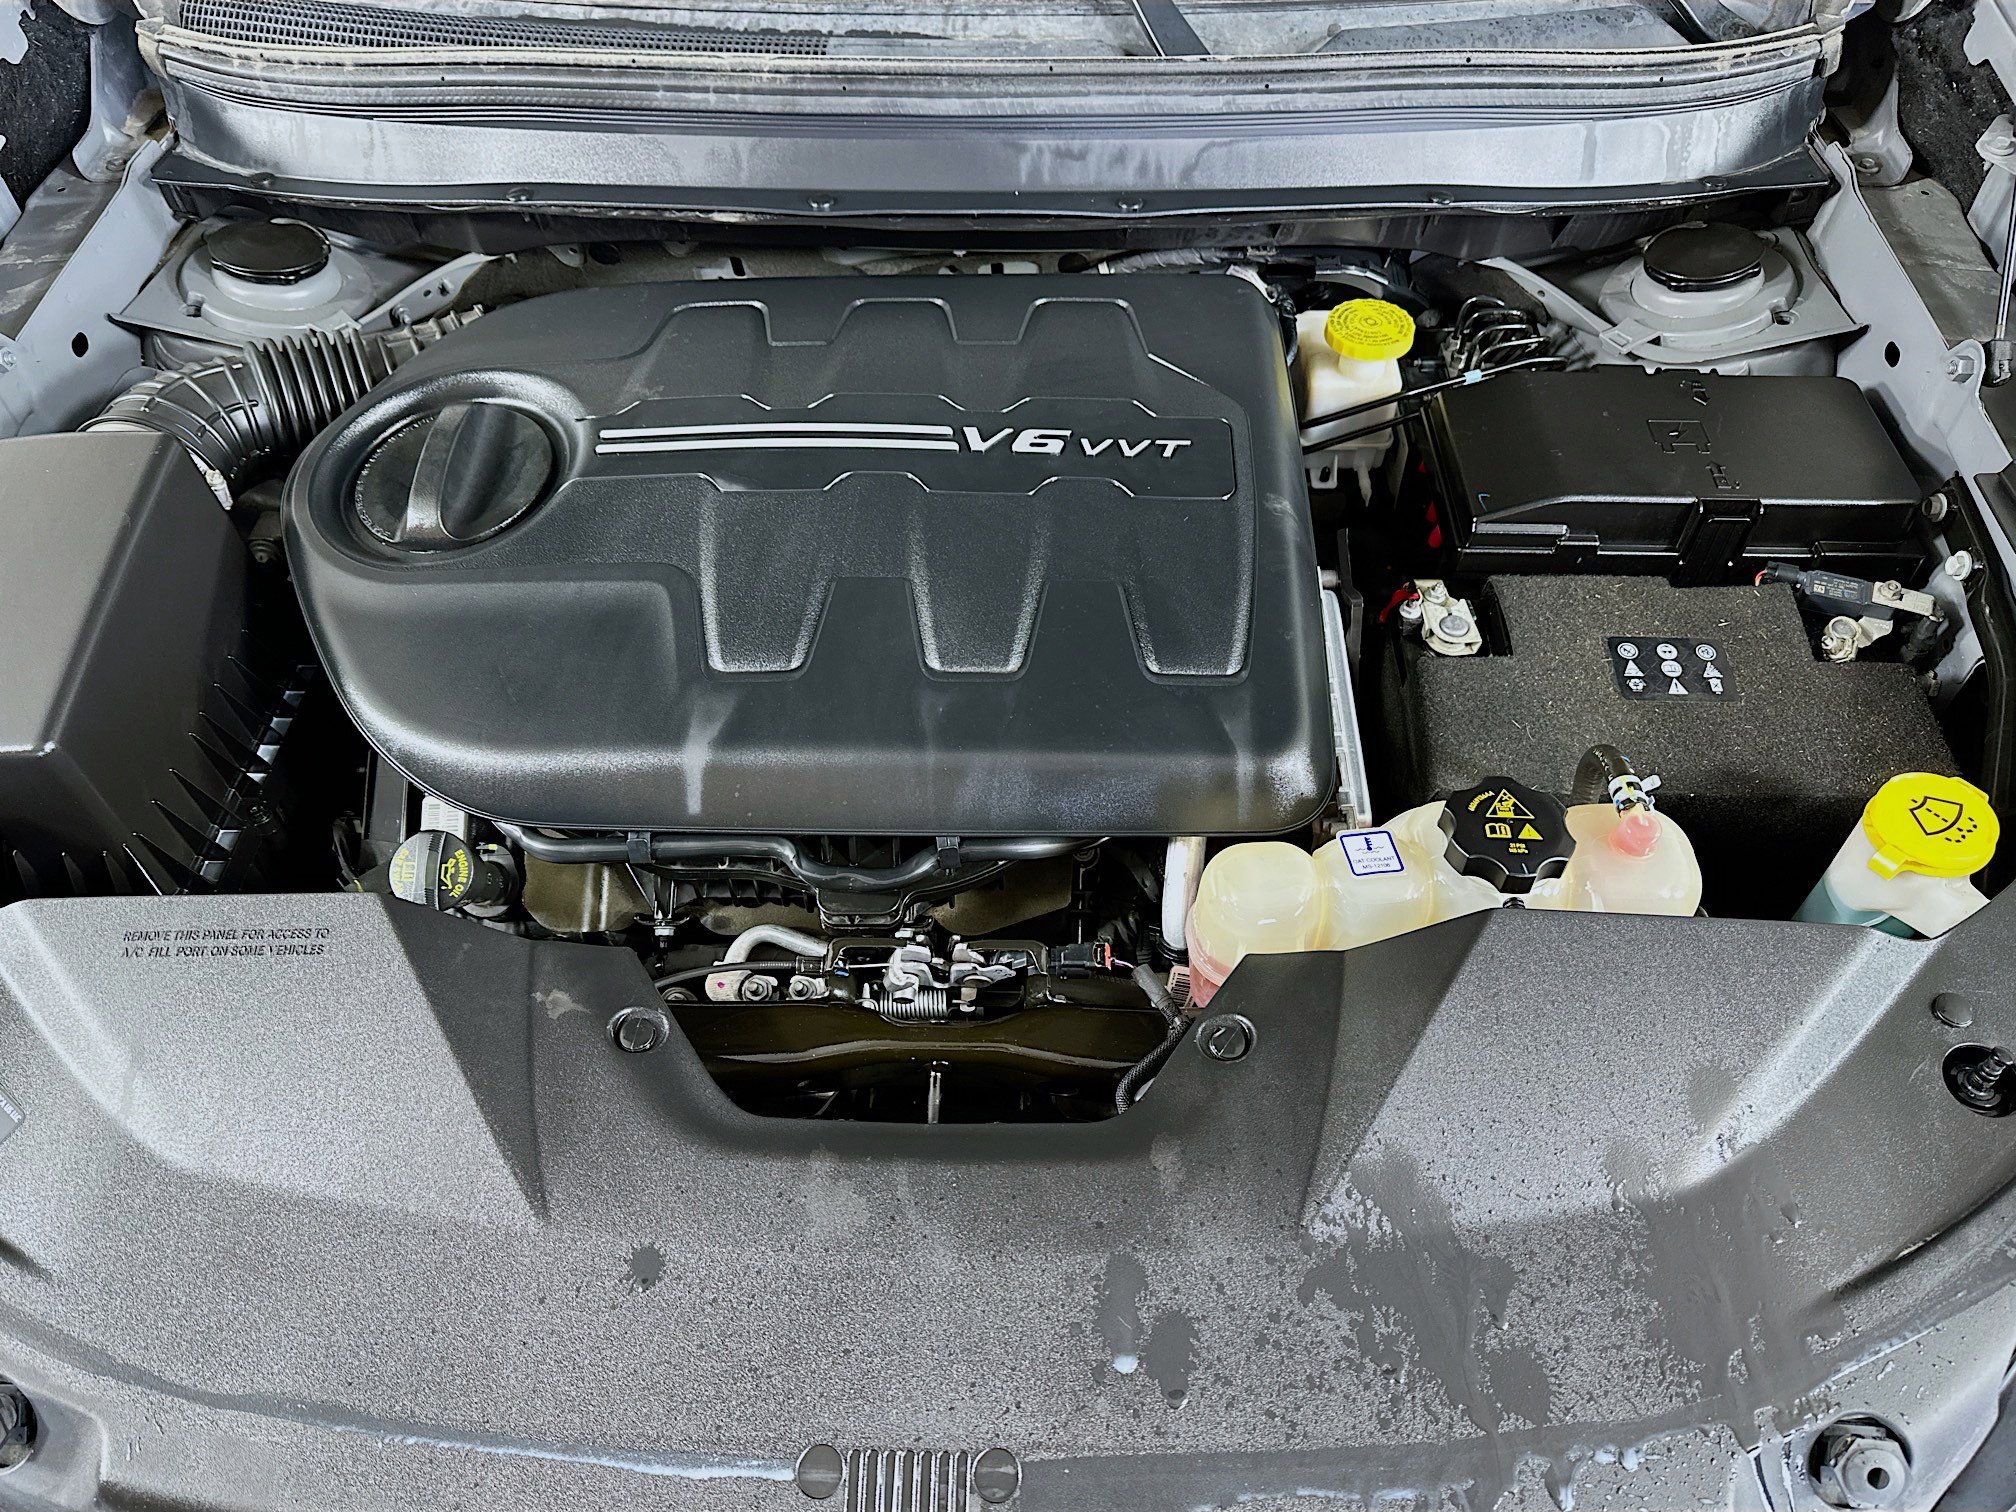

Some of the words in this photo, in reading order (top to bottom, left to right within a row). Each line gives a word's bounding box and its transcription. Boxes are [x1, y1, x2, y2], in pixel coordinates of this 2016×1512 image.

[962, 426, 1073, 456] V6
[1079, 437, 1192, 458] VVT
[454, 849, 468, 883] ENGINE
[449, 884, 464, 897] OIL
[123, 930, 172, 942] REMOVE
[173, 930, 200, 941] THIS
[201, 929, 238, 940] PANEL
[240, 929, 265, 940] FOR
[266, 928, 312, 940] ACCESS
[314, 928, 330, 939] TO
[147, 946, 171, 957] FILL
[175, 946, 208, 957] PORT
[210, 945, 229, 956] ON
[230, 945, 265, 956] SOME
[268, 944, 325, 956] VEHICLES
